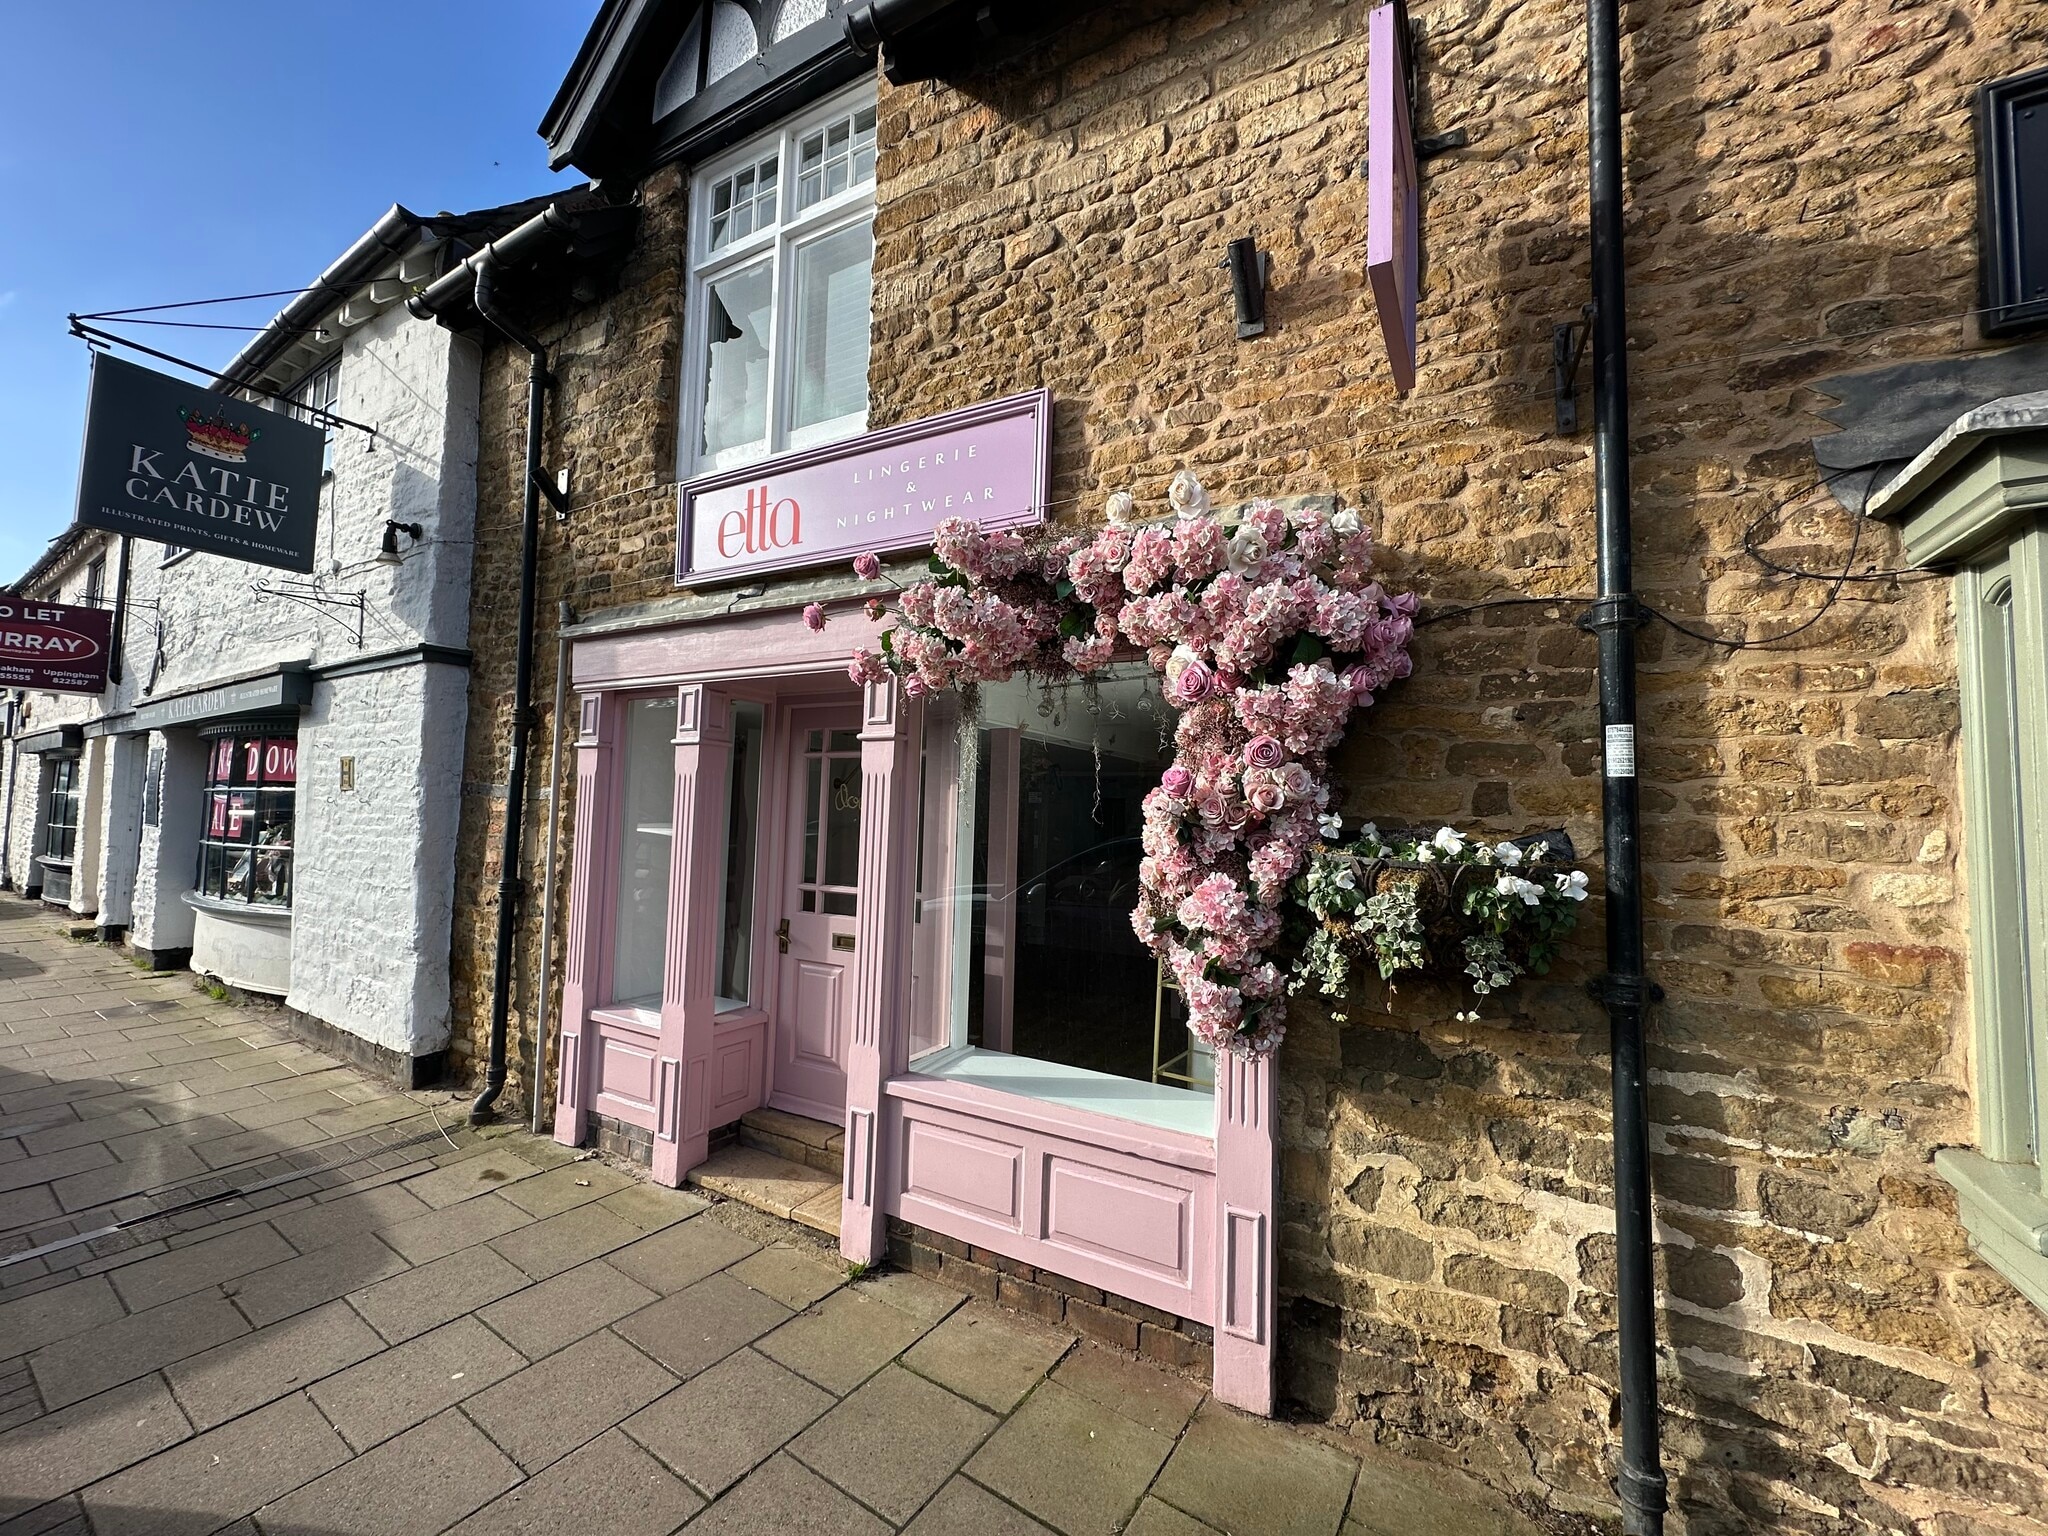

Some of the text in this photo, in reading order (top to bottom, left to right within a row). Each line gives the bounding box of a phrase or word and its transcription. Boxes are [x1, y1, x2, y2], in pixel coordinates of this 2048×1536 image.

[129, 444, 290, 513] KATIE
[854, 444, 978, 484] LINGERIE
[126, 478, 286, 533] CARDEW
[906, 481, 917, 493] &
[718, 485, 803, 559] etta
[837, 487, 995, 528] NIGHTWEAR
[101, 506, 171, 528] ILLUSTRATED
[173, 523, 211, 538] PRINTS,
[214, 533, 240, 544] GIFTS
[251, 541, 300, 558] HOMEWARE
[24, 607, 65, 622] LET
[0, 631, 82, 653] RRAY
[43, 668, 99, 680] Uppingham
[52, 677, 89, 686] 822587
